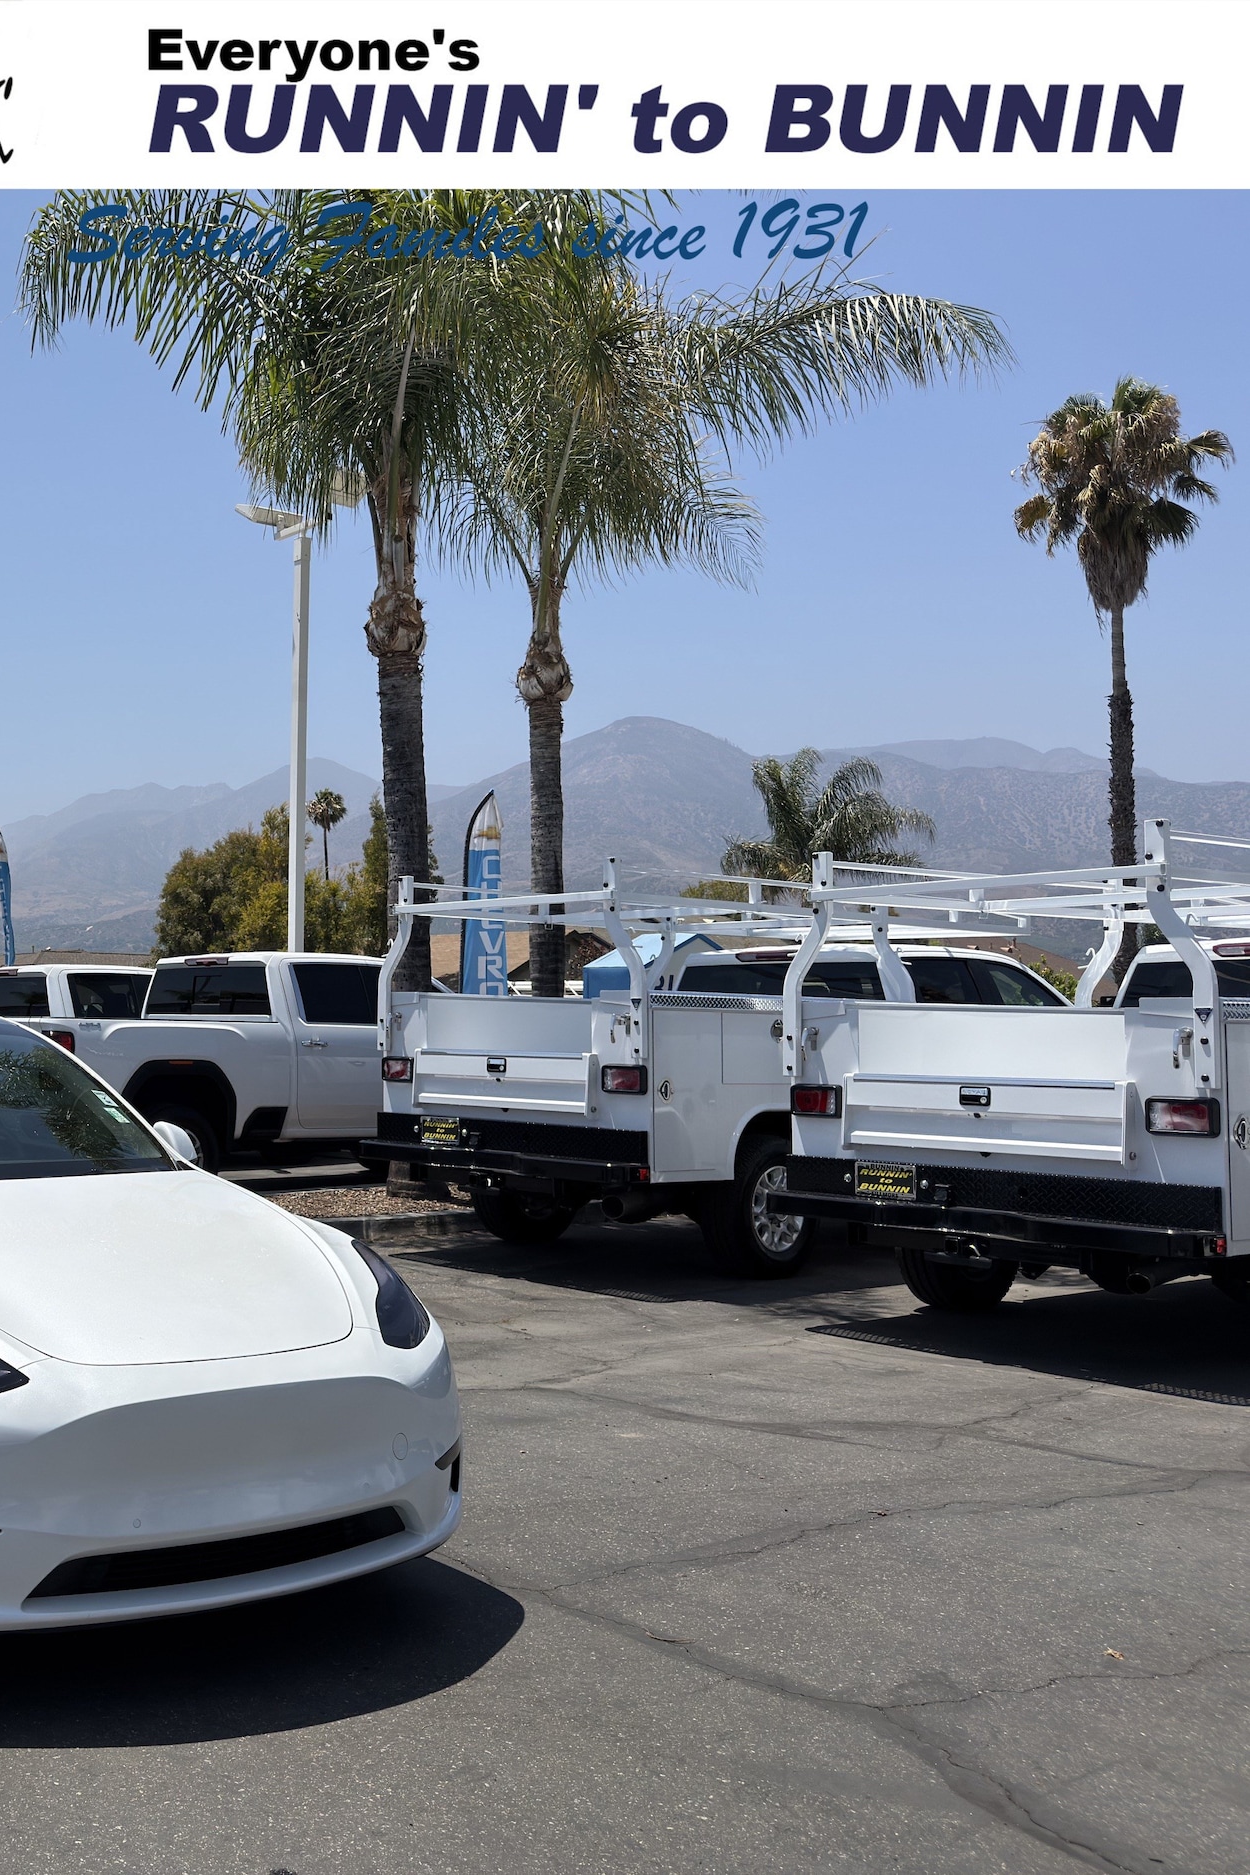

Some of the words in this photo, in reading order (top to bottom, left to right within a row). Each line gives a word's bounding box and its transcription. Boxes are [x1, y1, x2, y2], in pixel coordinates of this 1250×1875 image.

[423, 1132, 457, 1140] BUNNIN
[860, 1168, 912, 1178] RUNNIN'
[860, 1182, 910, 1193] BUNNIN
